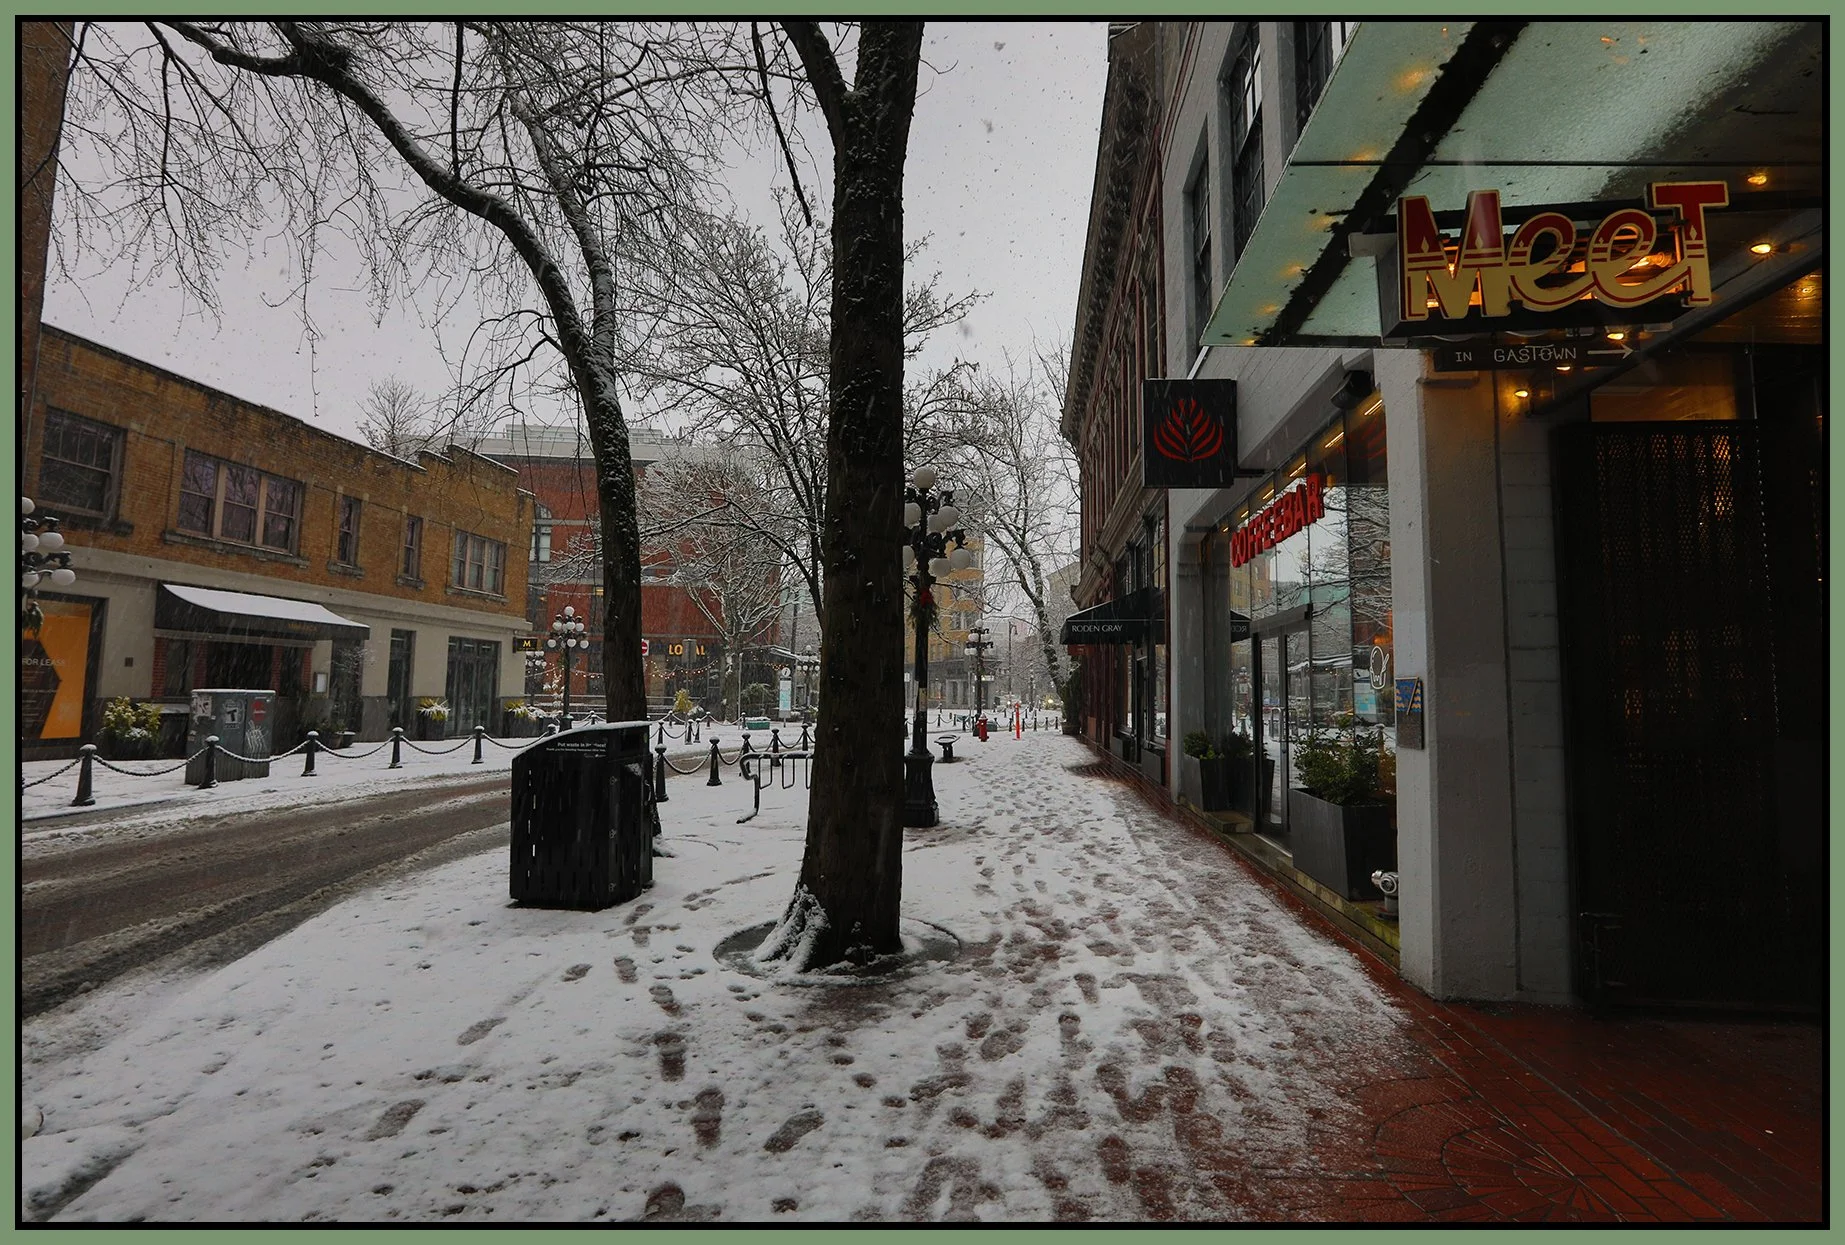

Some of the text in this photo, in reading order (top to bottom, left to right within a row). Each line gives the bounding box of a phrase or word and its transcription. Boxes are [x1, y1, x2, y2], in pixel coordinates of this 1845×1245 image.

[1455, 344, 1577, 363] IN GASTOWN
[1230, 472, 1325, 568] COFFEEBAR
[1071, 624, 1123, 633] RODEN GRAY
[522, 639, 531, 648] M
[668, 644, 706, 656] LOL
[22, 657, 39, 666] FOR
